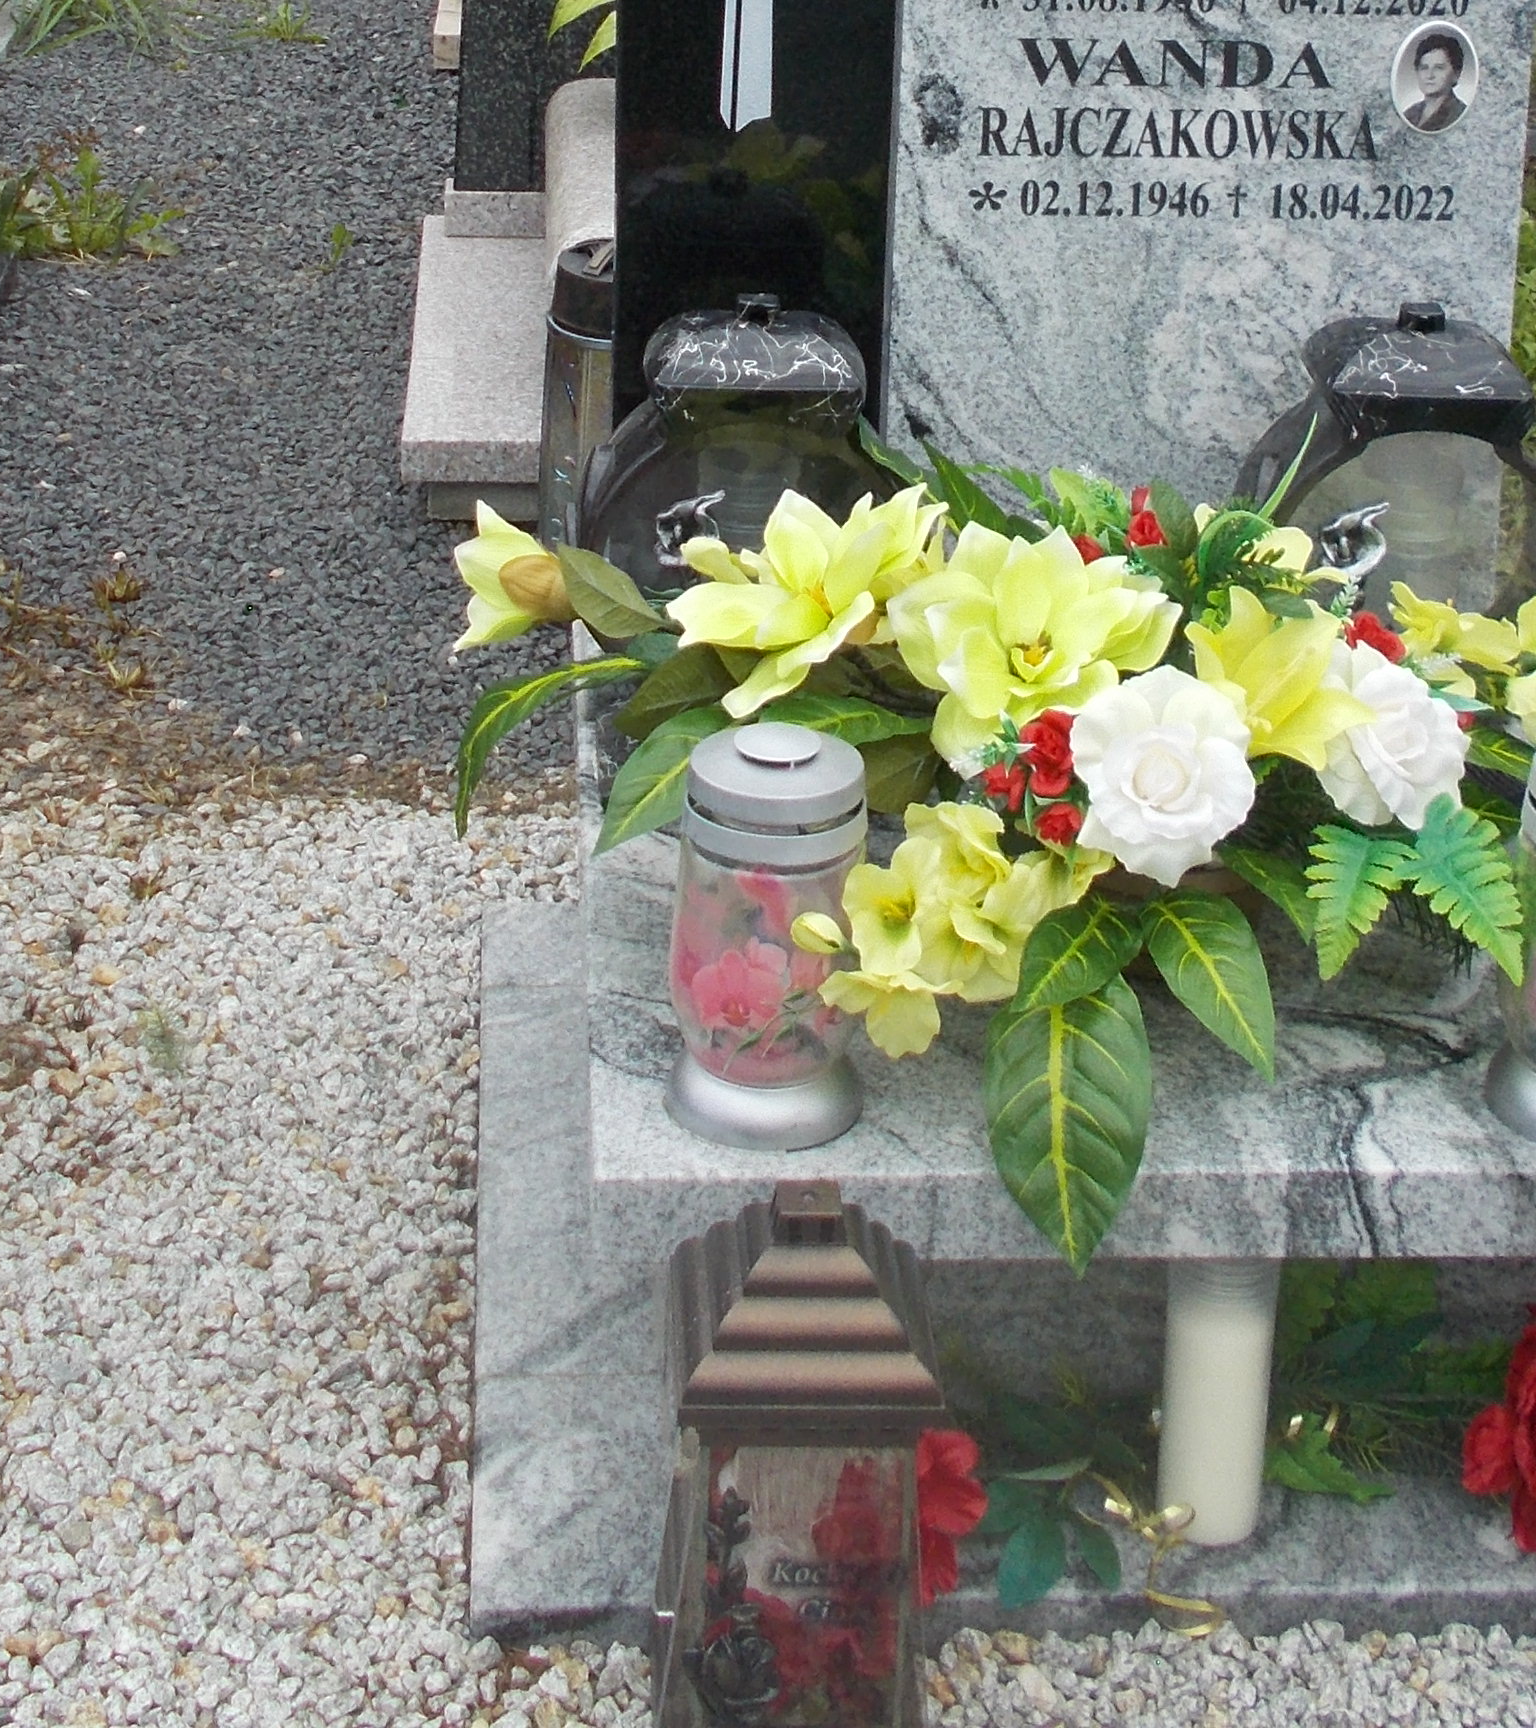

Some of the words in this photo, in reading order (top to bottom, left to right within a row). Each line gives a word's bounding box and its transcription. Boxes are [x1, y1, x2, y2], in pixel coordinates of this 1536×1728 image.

[1018, 37, 1332, 89] WANDA
[978, 105, 1379, 162] RAJCZAKOWSKA
[1020, 180, 1210, 218] 02.12.1946
[1270, 183, 1454, 221] 18.04.2022
